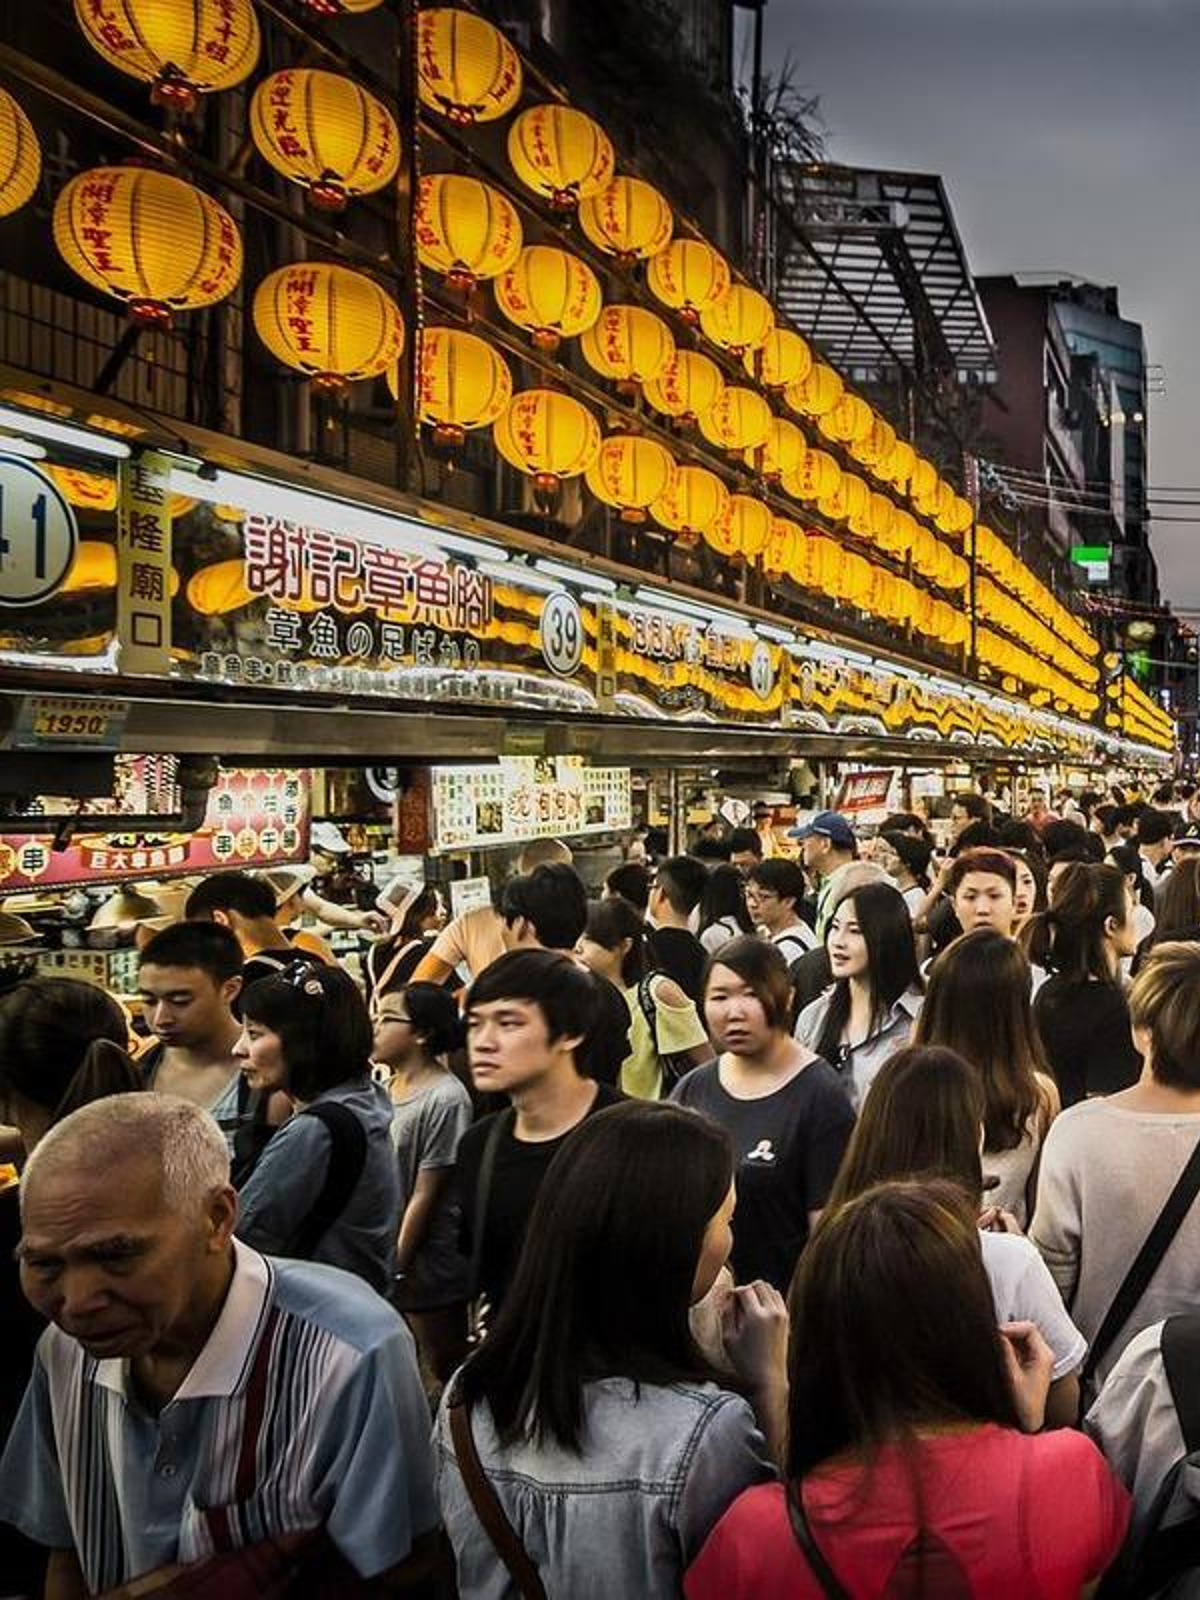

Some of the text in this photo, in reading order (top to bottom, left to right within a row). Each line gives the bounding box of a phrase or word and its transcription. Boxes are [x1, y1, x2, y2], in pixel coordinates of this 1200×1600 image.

[245, 514, 494, 634] 謝記章魚腳
[548, 606, 579, 660] 39
